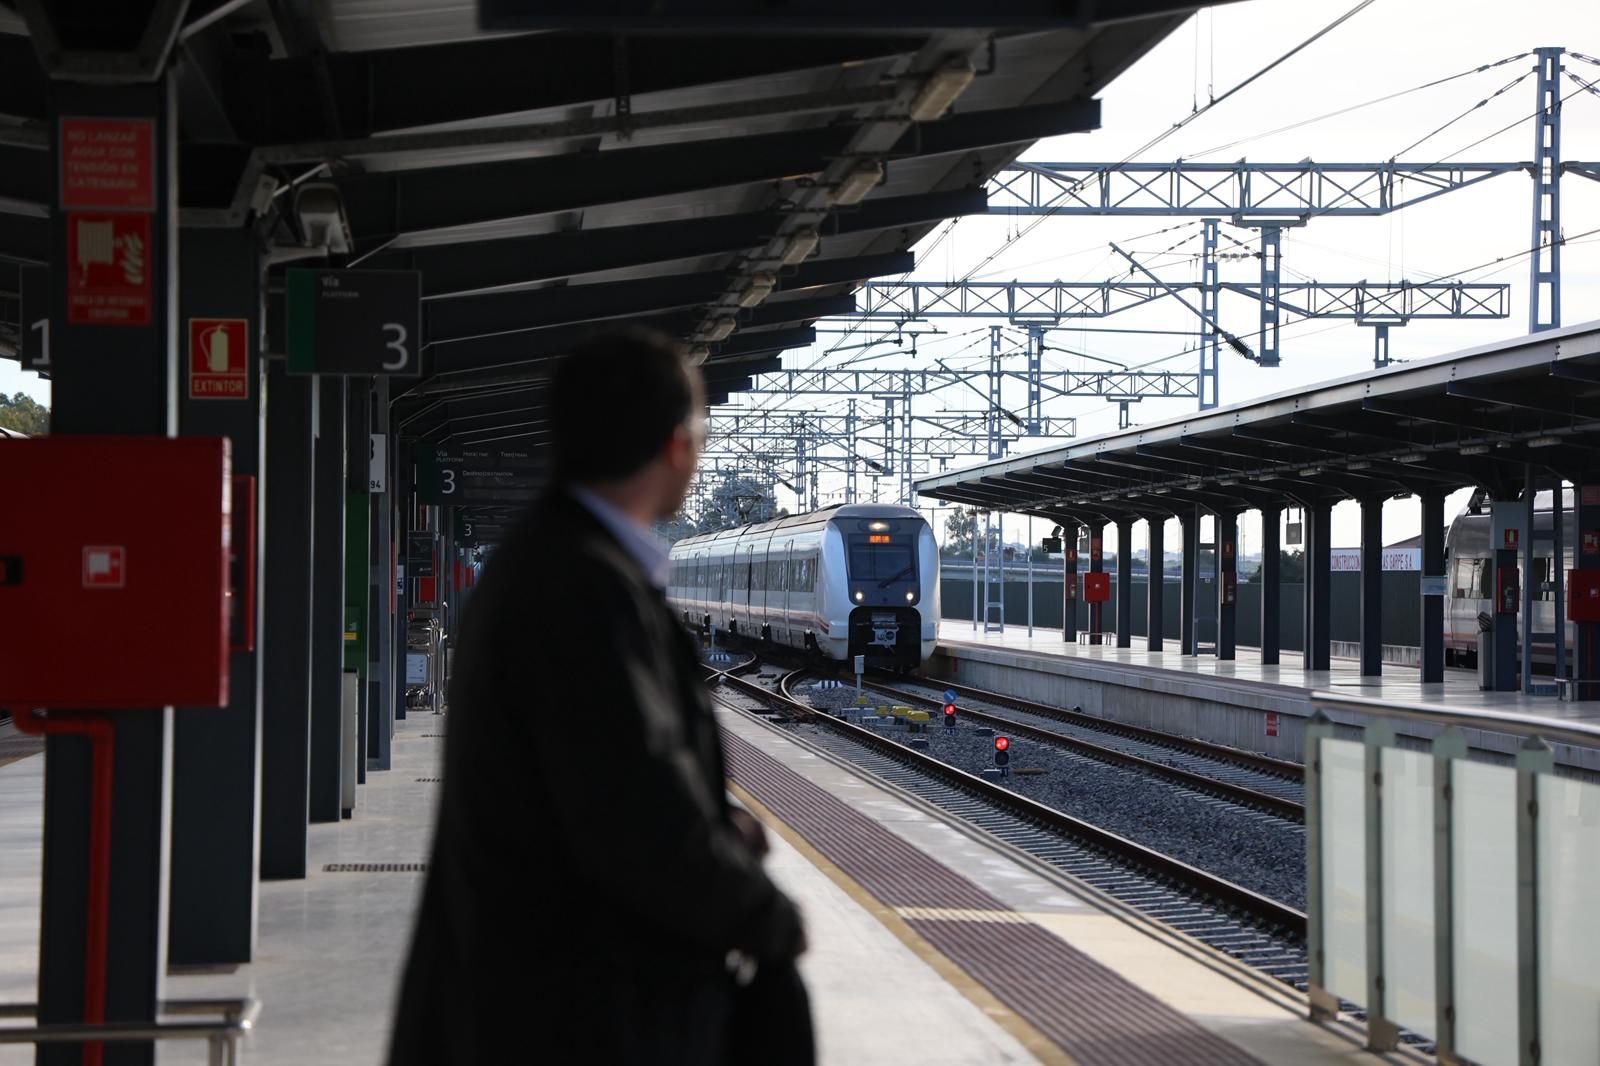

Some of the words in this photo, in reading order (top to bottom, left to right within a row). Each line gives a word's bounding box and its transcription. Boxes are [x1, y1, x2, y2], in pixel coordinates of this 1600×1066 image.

[382, 322, 408, 370] 3
[193, 380, 244, 393] EXTINTOR
[441, 469, 456, 494] 3
[464, 523, 472, 537] 3
[1043, 544, 1049, 553] 5
